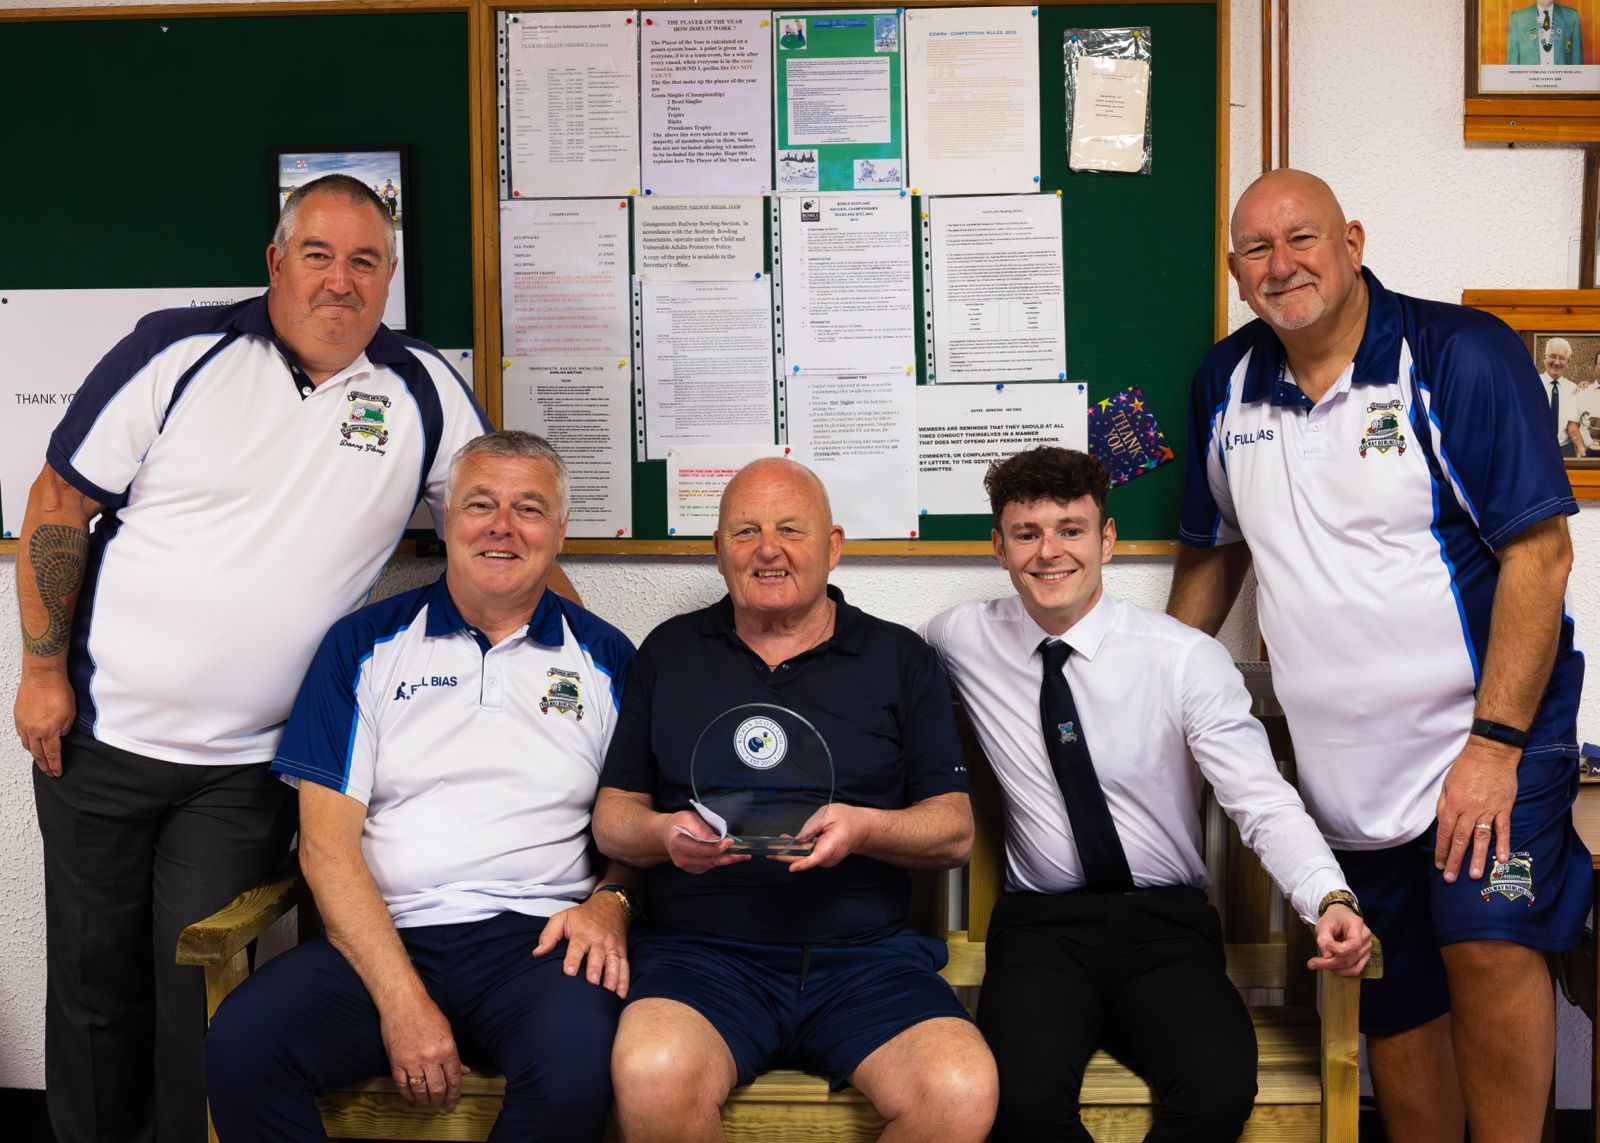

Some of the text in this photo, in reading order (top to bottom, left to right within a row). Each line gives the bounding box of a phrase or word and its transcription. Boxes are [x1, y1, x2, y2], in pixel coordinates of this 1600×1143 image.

[15, 394, 75, 404] THANK YO
[1104, 412, 1144, 459] THANK YOU
[340, 439, 363, 451] Danny
[411, 676, 457, 694] FL BIAS
[737, 720, 784, 744] BOWLS SCOTLAND
